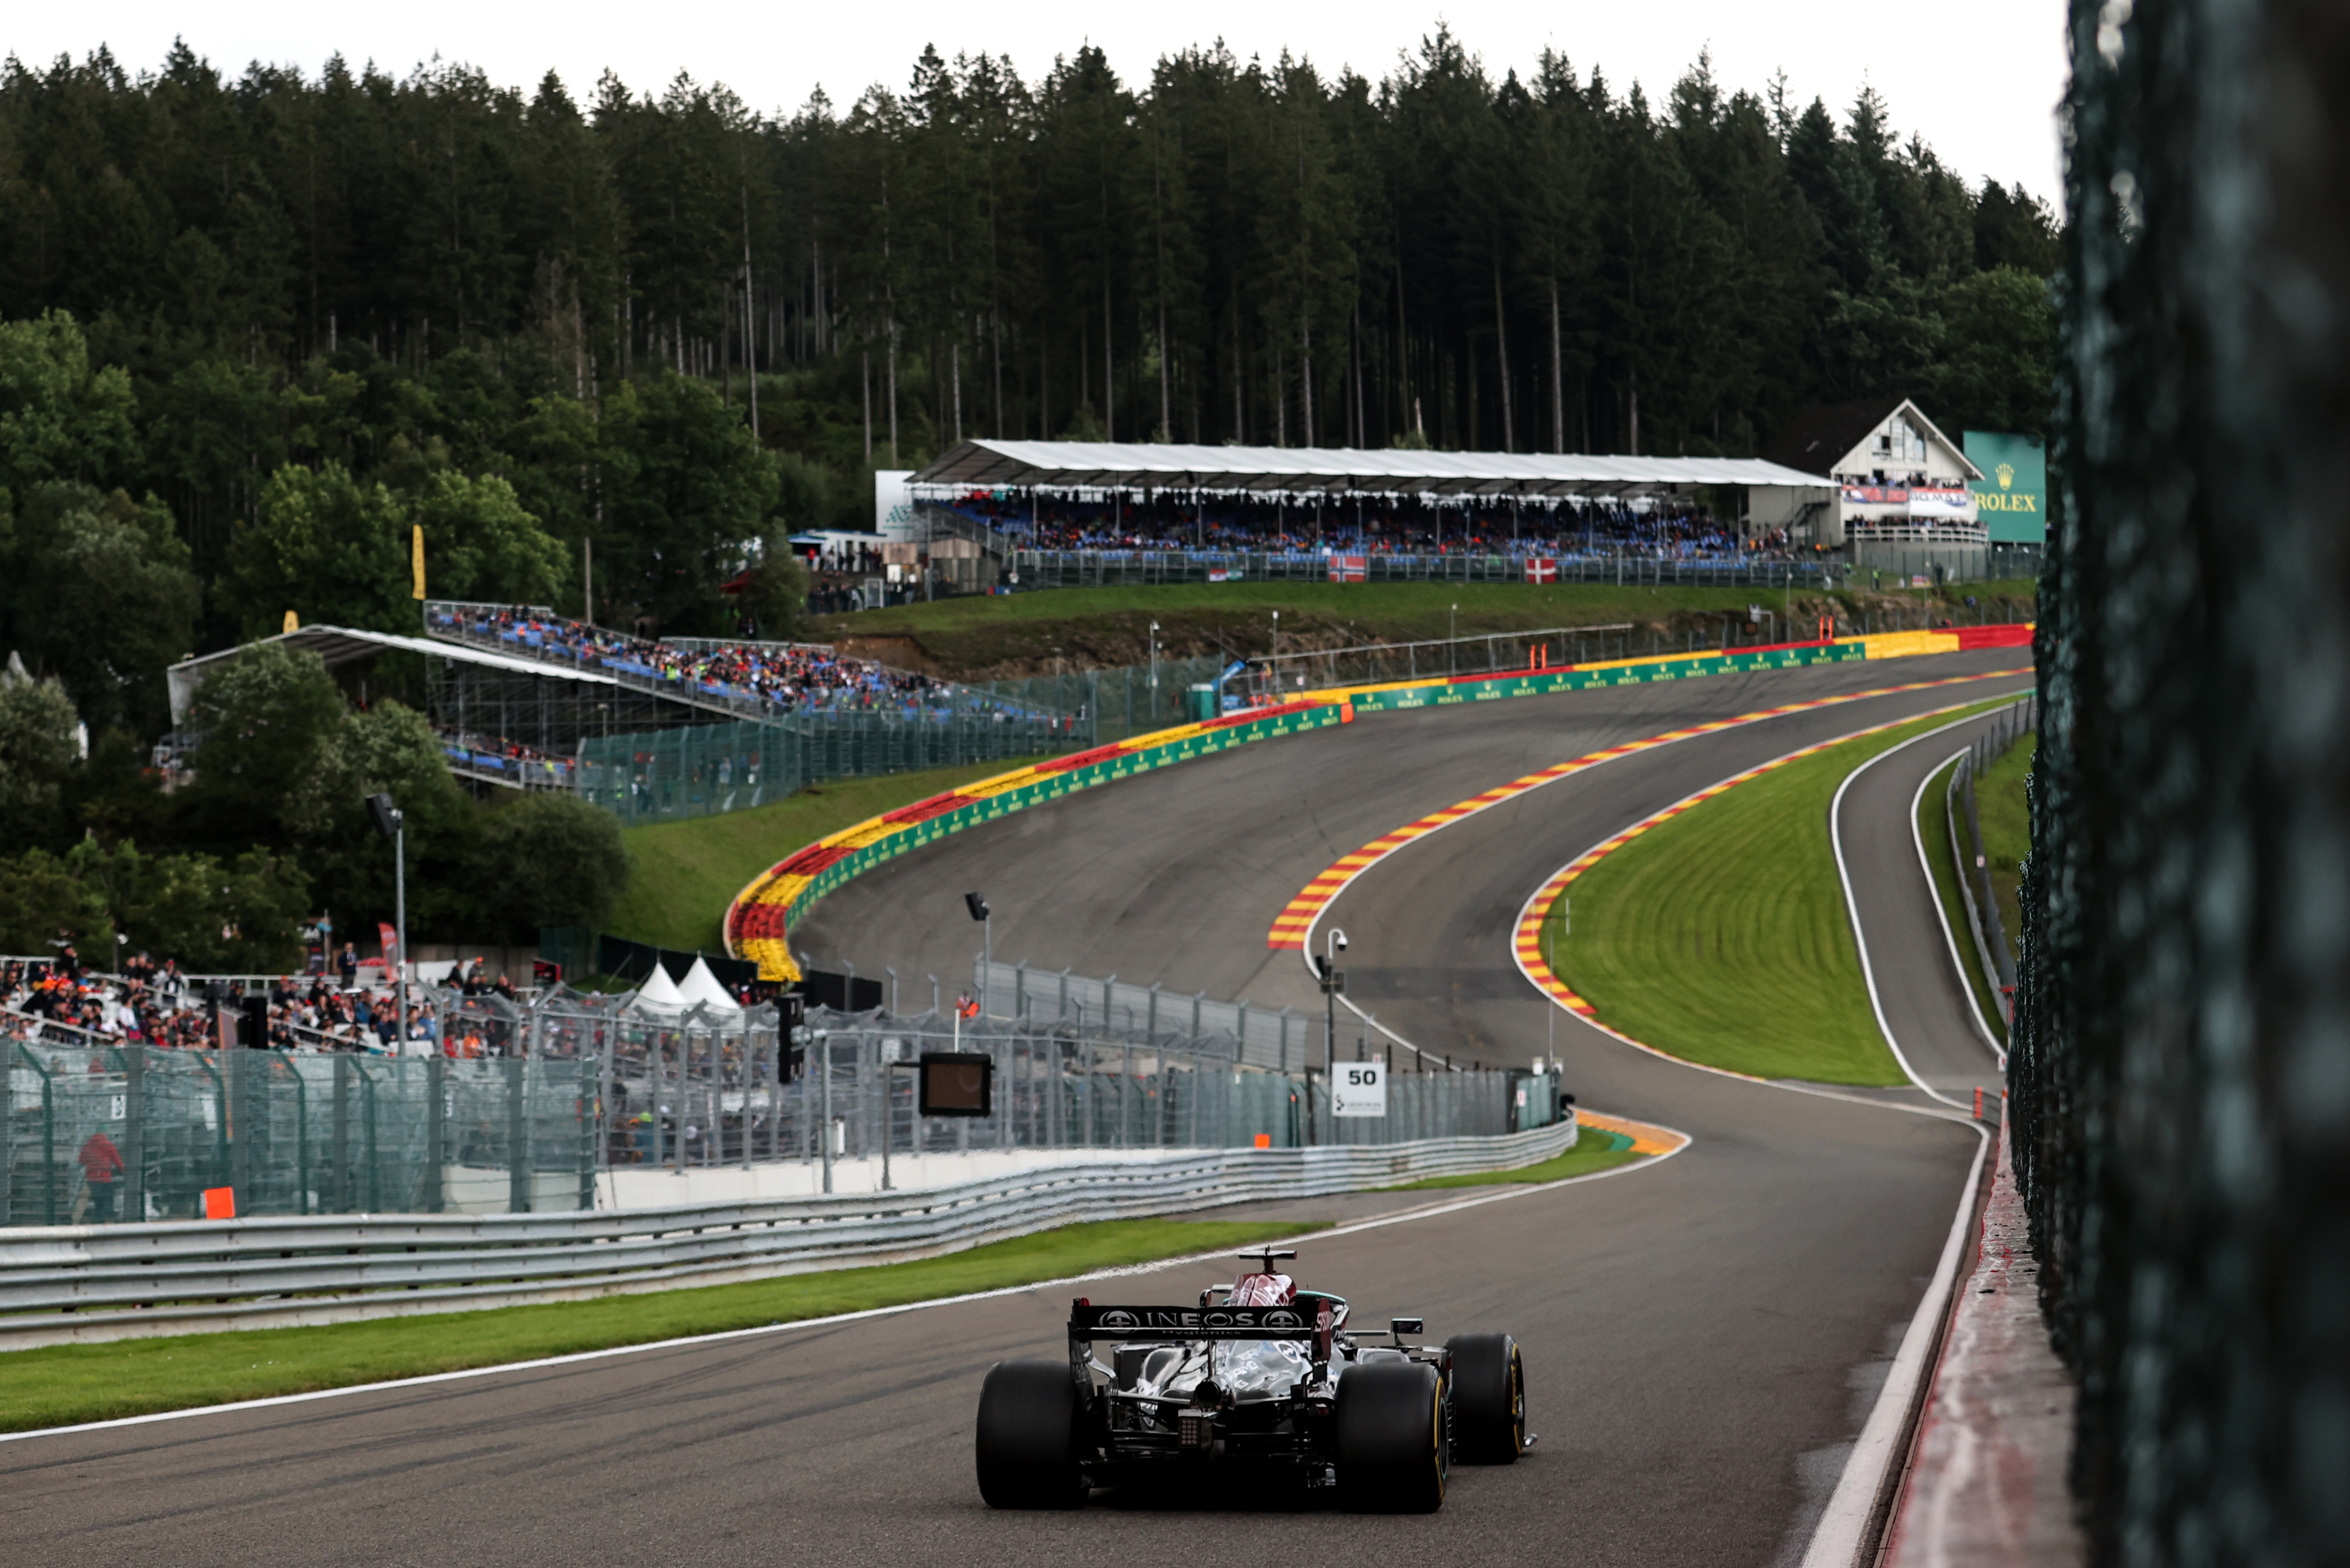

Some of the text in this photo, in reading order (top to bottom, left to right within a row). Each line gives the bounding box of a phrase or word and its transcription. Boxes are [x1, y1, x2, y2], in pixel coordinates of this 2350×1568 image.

[1975, 493, 2037, 512] ROLEX
[1349, 1070, 1376, 1085] 50
[1145, 1312, 1255, 1327] INEOS
